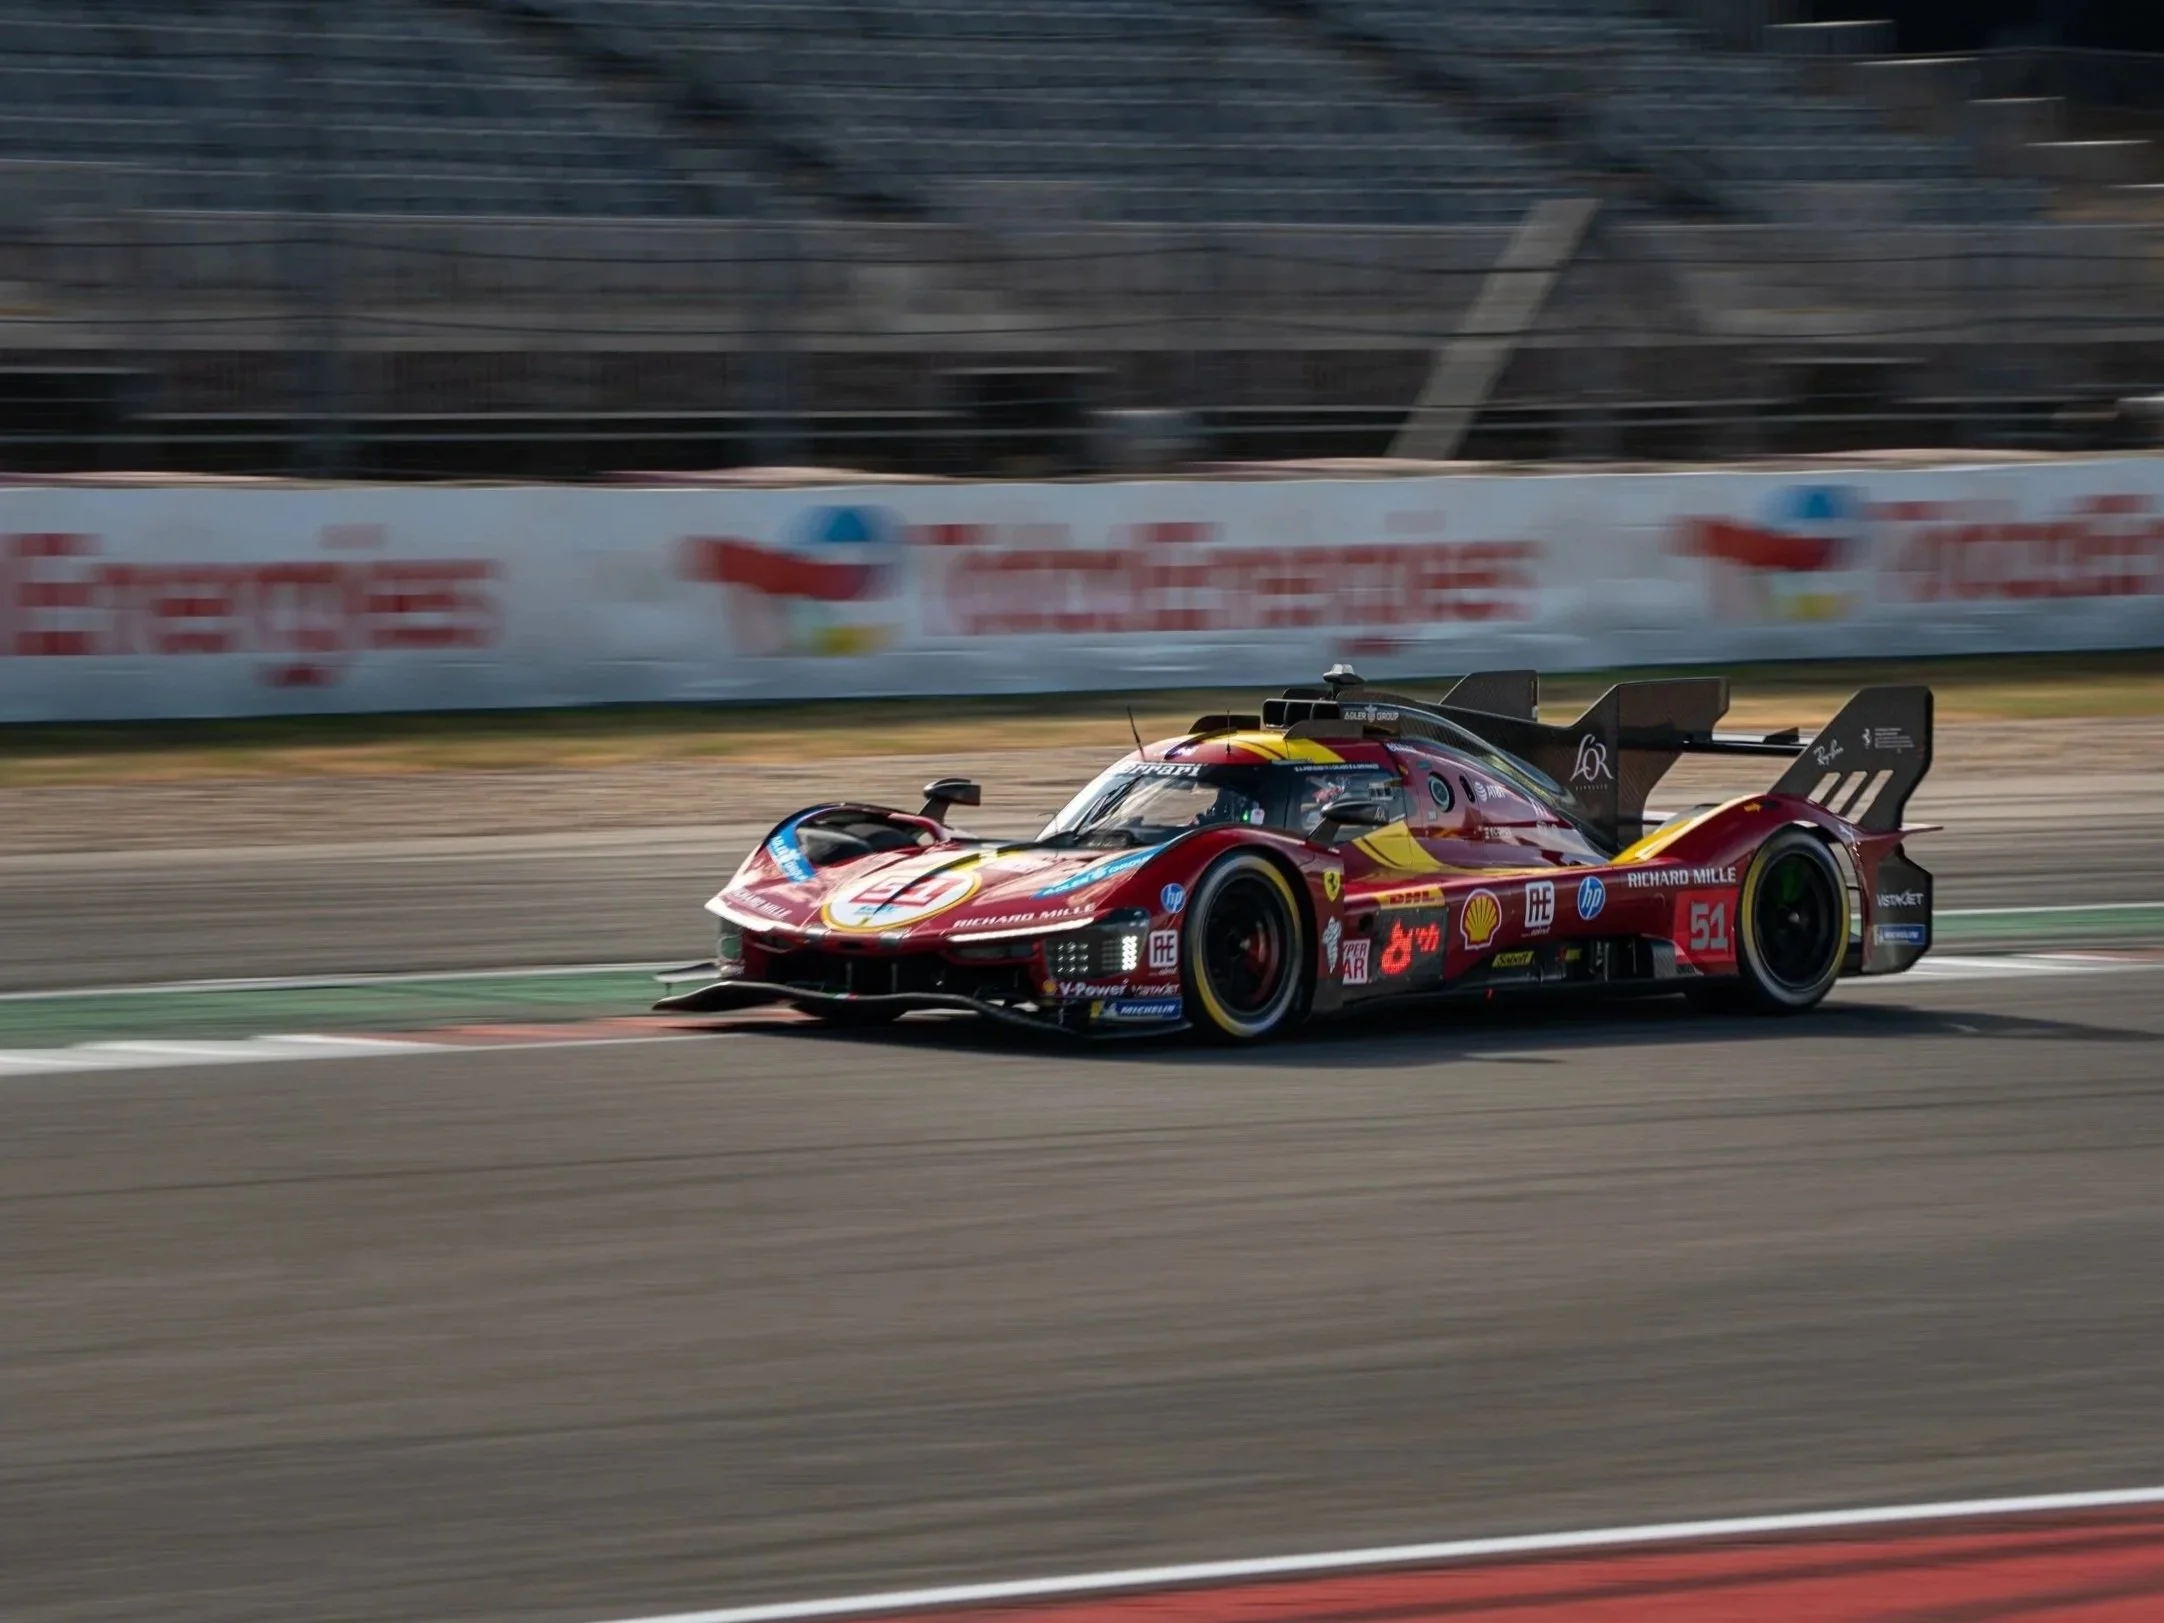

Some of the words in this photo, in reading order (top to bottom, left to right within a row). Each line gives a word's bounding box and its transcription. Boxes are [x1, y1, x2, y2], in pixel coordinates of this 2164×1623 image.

[1376, 711, 1400, 720] GROUP
[1627, 870, 1690, 888] RICHARD
[1693, 866, 1737, 884] MILLE
[1166, 885, 1183, 912] hp
[1581, 877, 1602, 919] hp
[952, 909, 1034, 928] RICHARD
[1038, 903, 1097, 919] MILLE
[1690, 901, 1729, 950] 51
[1058, 981, 1127, 996] V-Power
[1120, 1004, 1176, 1015] MICHELIN
